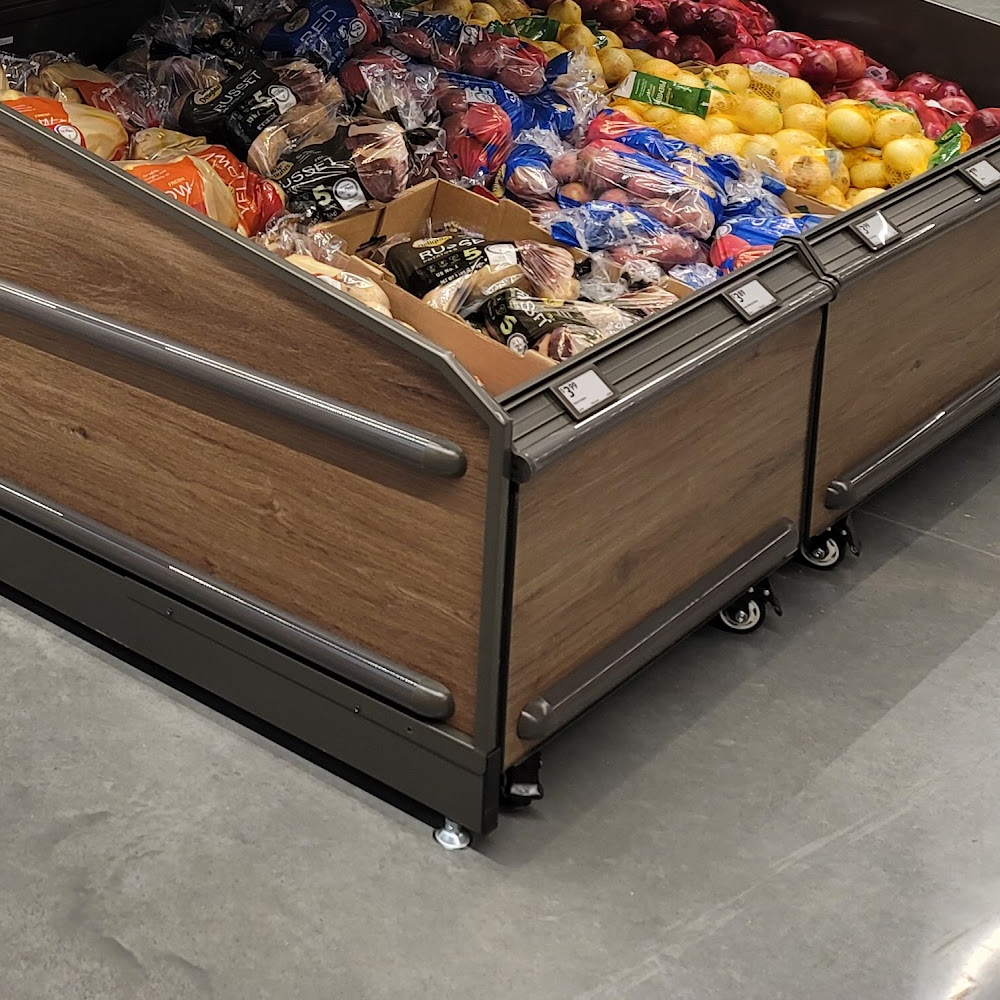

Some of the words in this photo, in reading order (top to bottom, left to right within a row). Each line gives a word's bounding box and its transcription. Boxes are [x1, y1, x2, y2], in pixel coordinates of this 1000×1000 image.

[300, 9, 337, 44] RED
[213, 69, 262, 113] RUSSET
[279, 156, 336, 189] USSET
[312, 184, 333, 207] 5
[463, 246, 482, 261] 5
[500, 314, 518, 336] 5
